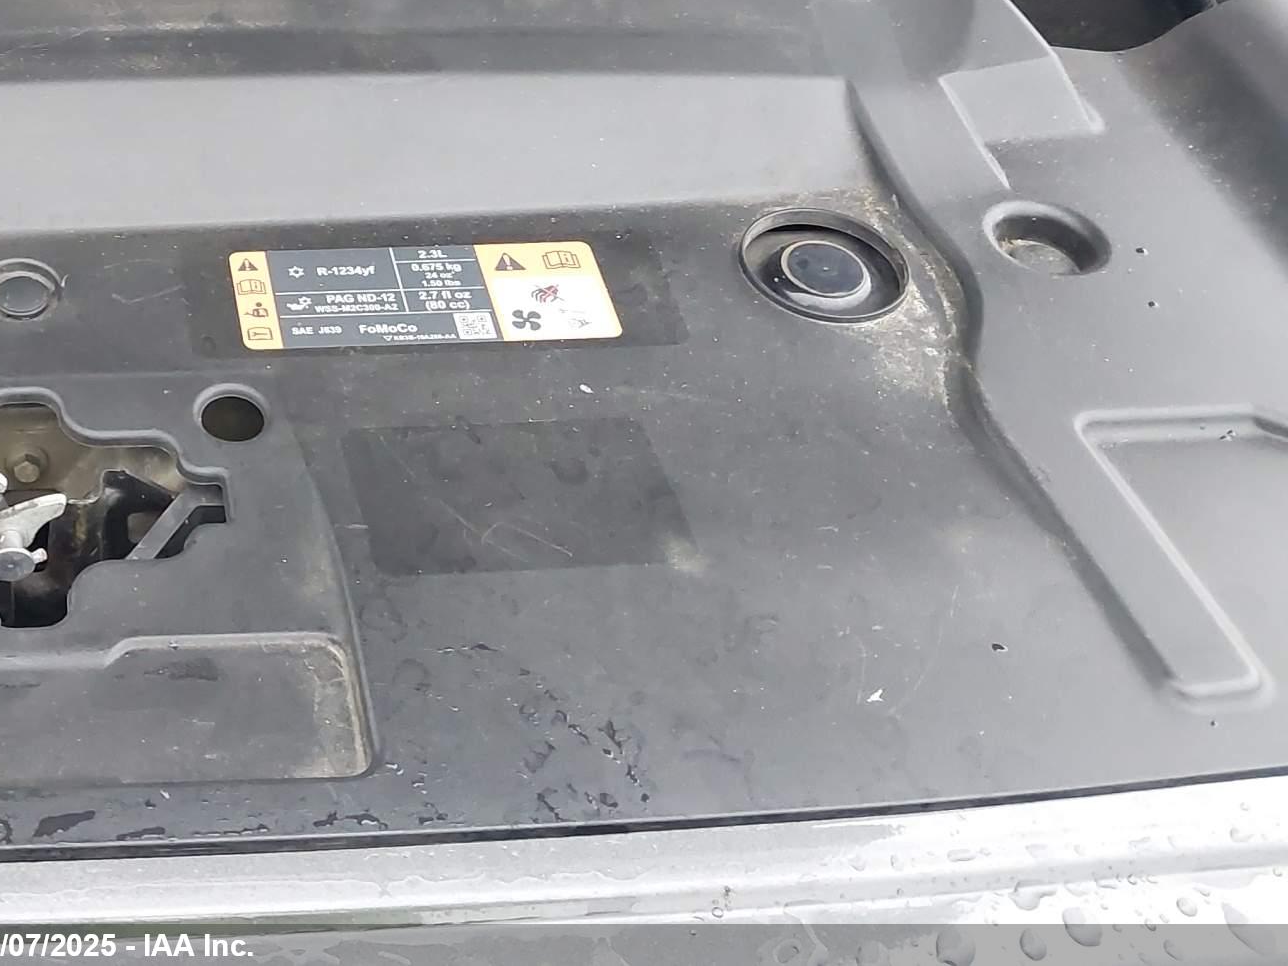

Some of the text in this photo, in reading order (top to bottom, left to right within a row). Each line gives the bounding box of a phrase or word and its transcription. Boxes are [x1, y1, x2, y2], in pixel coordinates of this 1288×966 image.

[417, 249, 448, 259] 2.3L
[316, 265, 375, 277] R-1234yf
[411, 262, 462, 273] 0.675 kg
[326, 293, 397, 303] PAG ND-12
[418, 290, 472, 300] 2.7 fl oz
[425, 299, 471, 311] (80 cc)
[291, 326, 315, 335] SAE
[358, 323, 418, 334] FoMoCo
